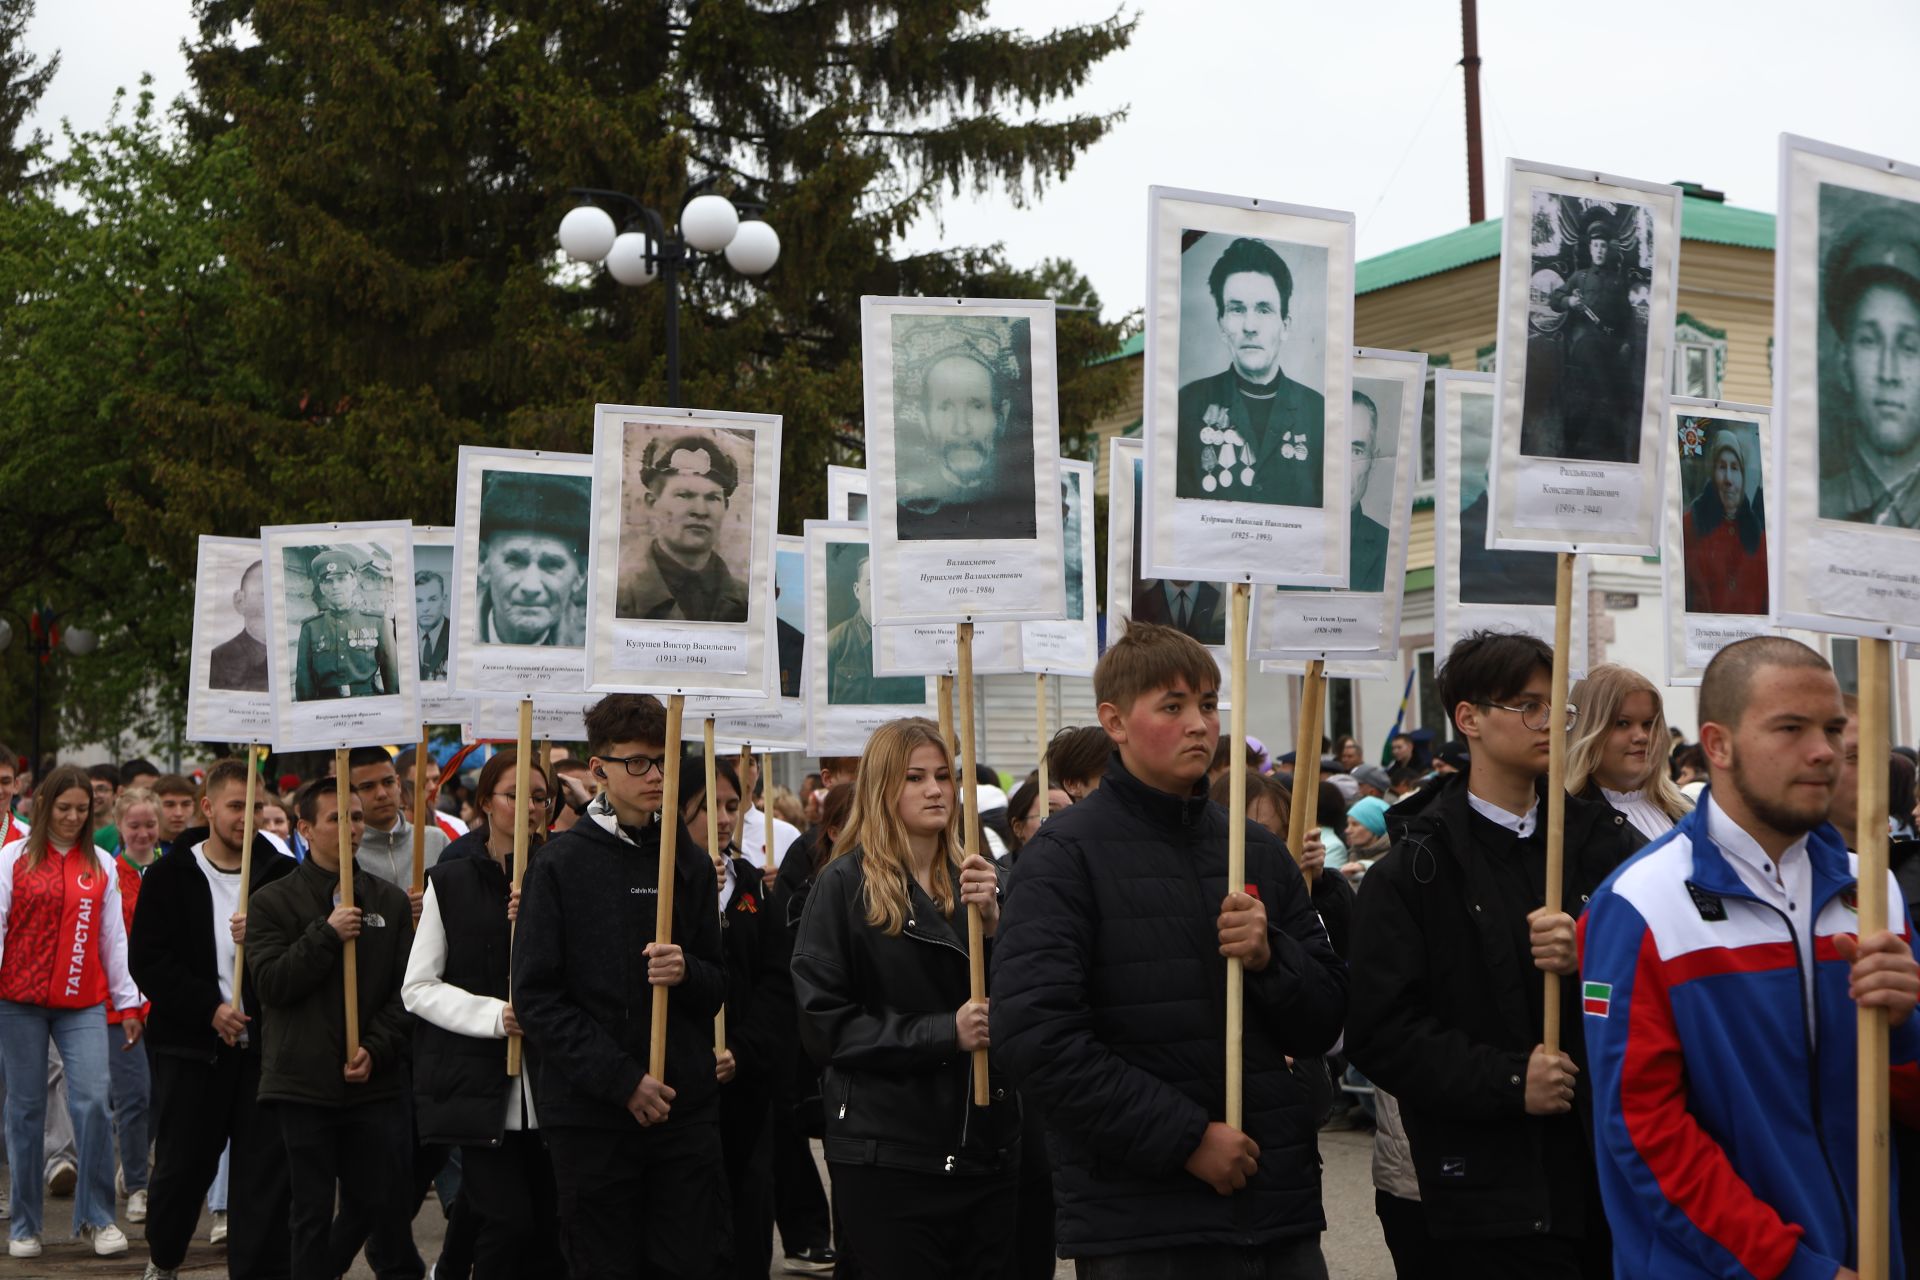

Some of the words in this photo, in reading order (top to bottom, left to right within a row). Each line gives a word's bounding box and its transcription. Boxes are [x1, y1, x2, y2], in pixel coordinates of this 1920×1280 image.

[1542, 483, 1585, 496] Константин
[1586, 486, 1620, 498] Иванович
[1235, 517, 1263, 526] Николай
[1265, 519, 1302, 529] Николаевич
[946, 558, 996, 567] Валиахметов
[920, 573, 963, 583] Нуриахмет
[964, 572, 1023, 581] Валиахметович
[948, 586, 968, 595] (1906
[976, 586, 995, 594] 1986)
[626, 639, 661, 650] Кулушев
[663, 641, 691, 651] Виктор
[693, 642, 737, 652] Васильевич
[655, 655, 677, 663] (1913
[686, 655, 707, 664] 1944)
[65, 898, 93, 997] ТАТАРСТАН
